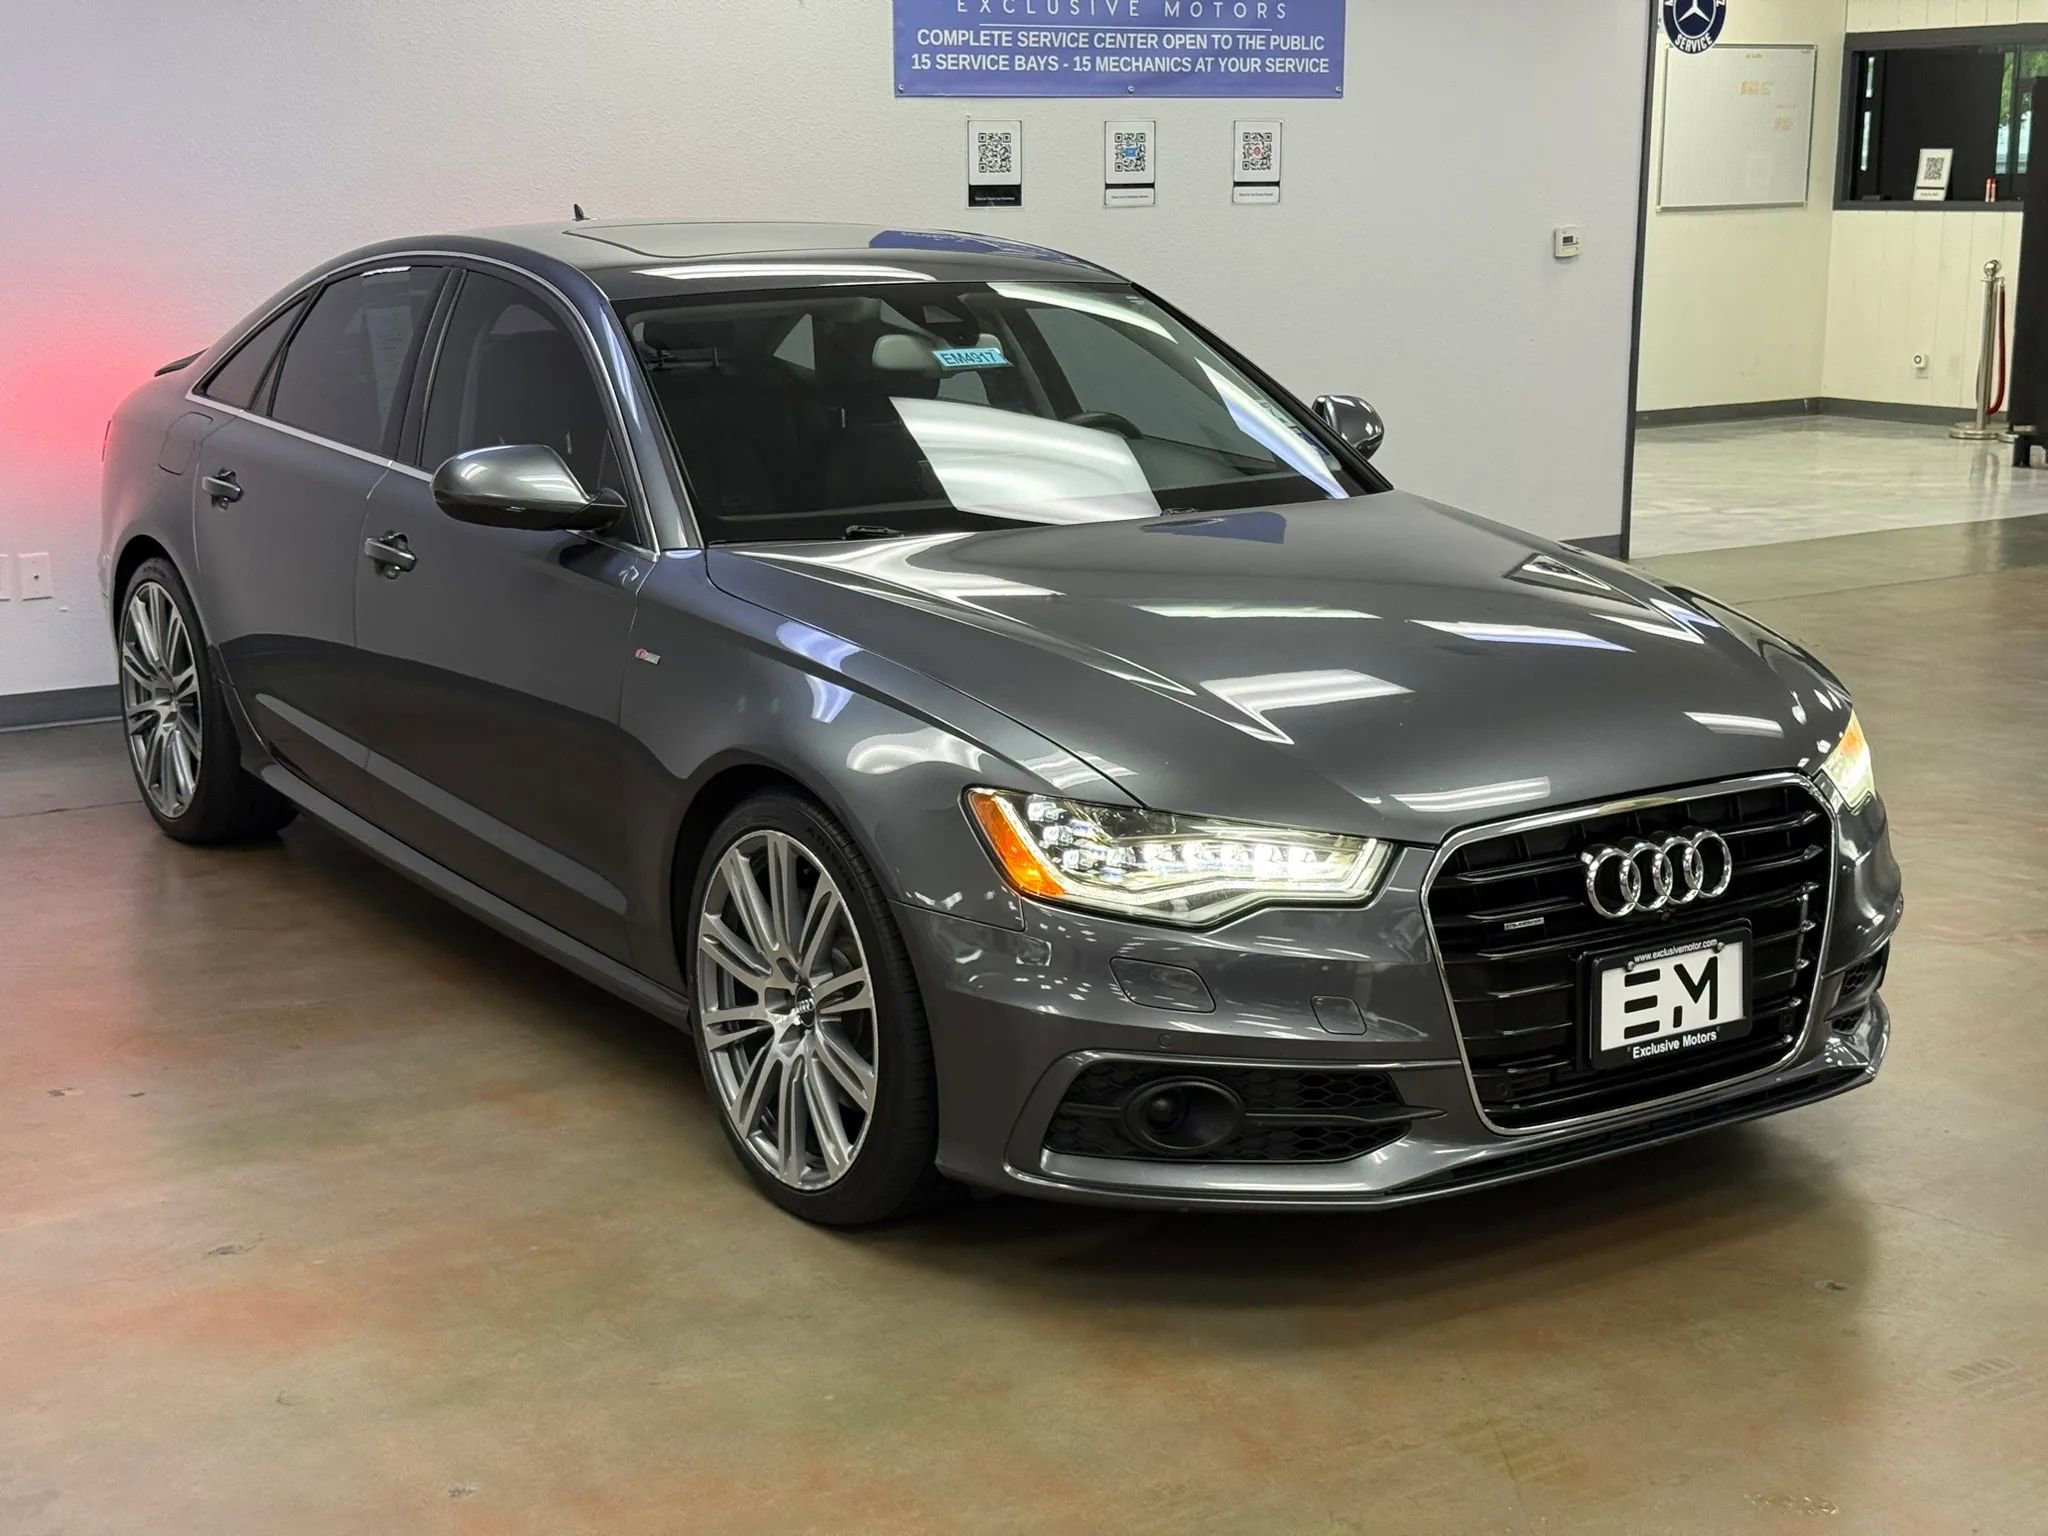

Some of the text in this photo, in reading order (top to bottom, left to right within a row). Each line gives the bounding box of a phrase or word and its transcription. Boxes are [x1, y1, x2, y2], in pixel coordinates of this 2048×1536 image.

[957, 0, 1286, 20] EXCLUSIVE MOTORS
[917, 29, 1325, 51] COMPLETE SERVICE CENTER OPEN TO THE PUBLIC
[1674, 32, 1713, 53] SERVICE
[911, 53, 932, 70] 15
[935, 54, 1010, 71] SERVICE
[1014, 55, 1059, 72] BAYS
[1073, 56, 1092, 72] 15
[1095, 56, 1192, 72] MECHANICS
[1194, 57, 1214, 73] AT
[1217, 57, 1261, 73] YOUR
[1265, 58, 1329, 74] SERVICE
[939, 351, 998, 365] EM4917
[1633, 938, 1718, 963] www.exclusivemotor.com
[1623, 956, 1719, 1040] EM
[1632, 1030, 1718, 1060] Exclusive Motors
